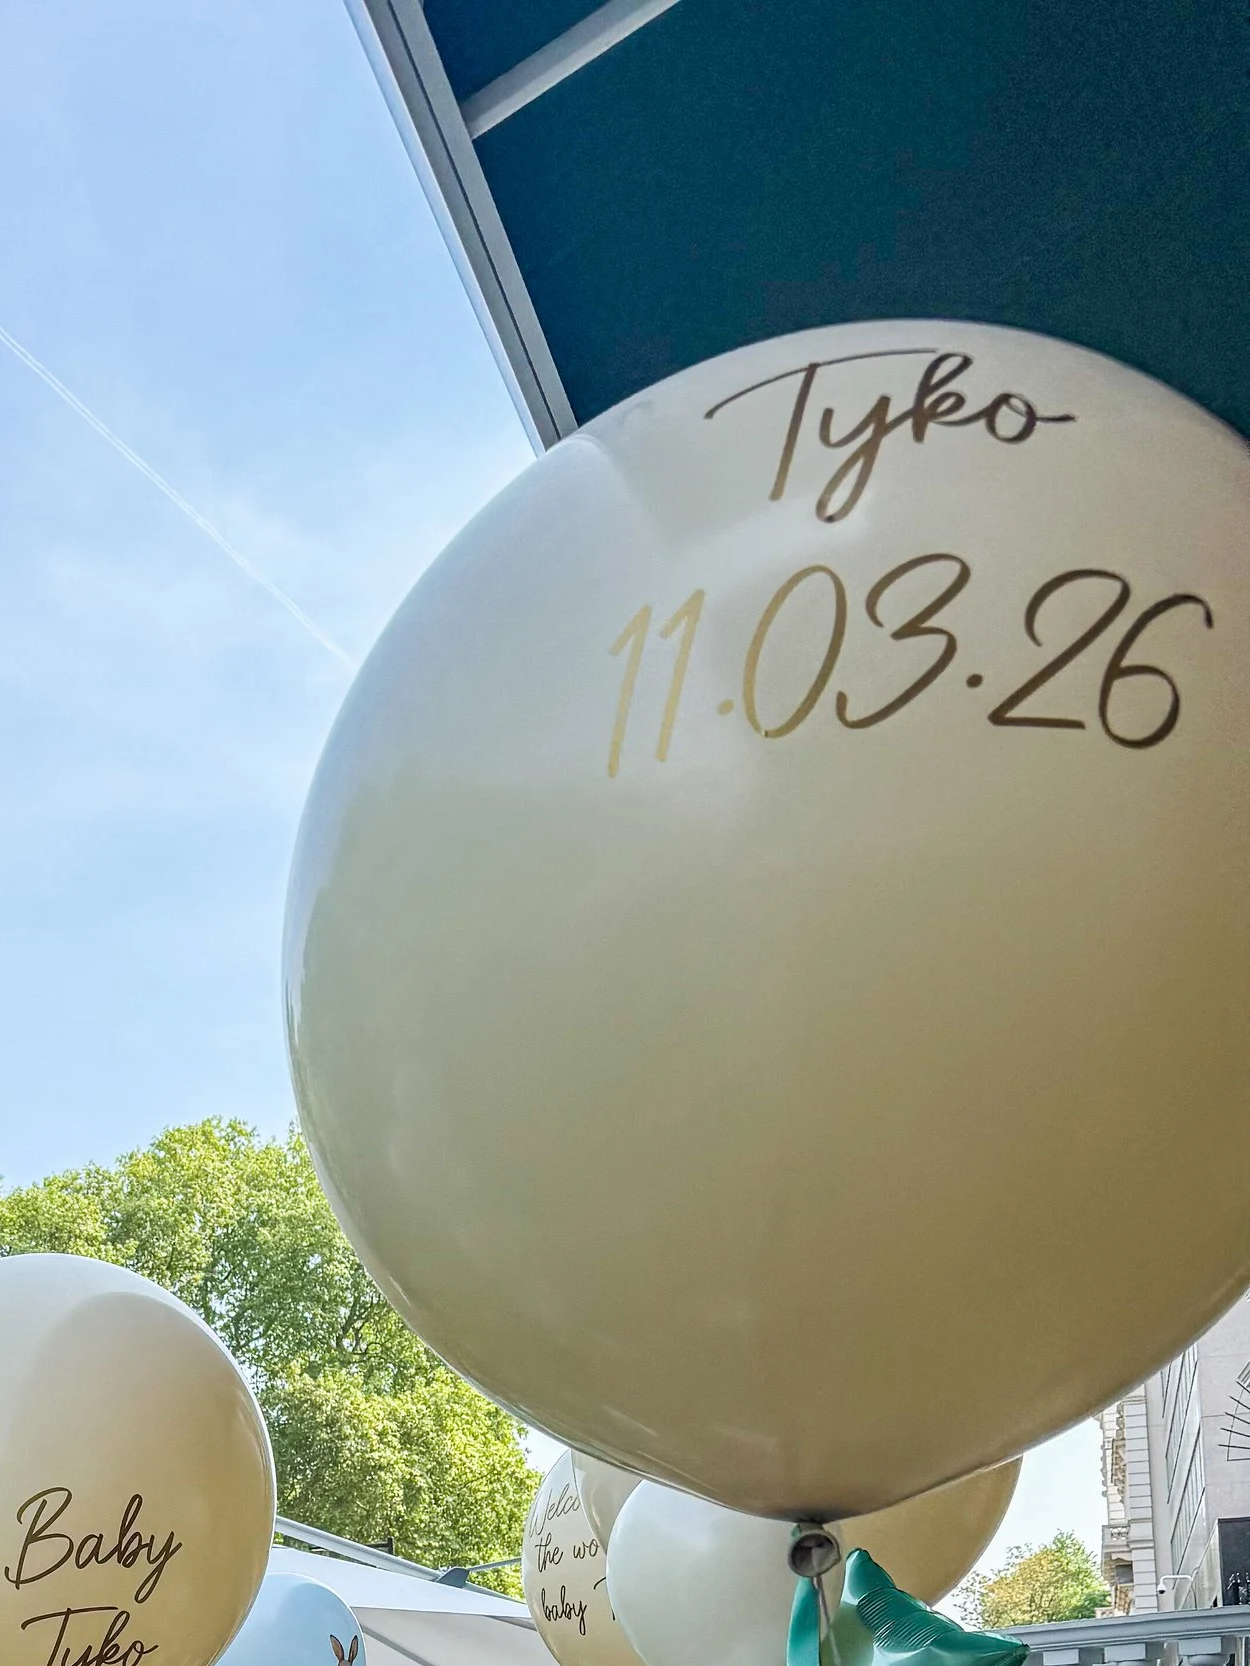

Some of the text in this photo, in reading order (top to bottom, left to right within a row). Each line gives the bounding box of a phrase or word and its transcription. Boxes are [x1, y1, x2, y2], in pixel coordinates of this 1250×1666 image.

[702, 345, 1078, 525] Tyko
[607, 551, 1215, 780] 11.03.26
[4, 1485, 183, 1604] Baby
[529, 1482, 581, 1538] Welco
[534, 1531, 600, 1573] the wo
[540, 1584, 588, 1636] baby
